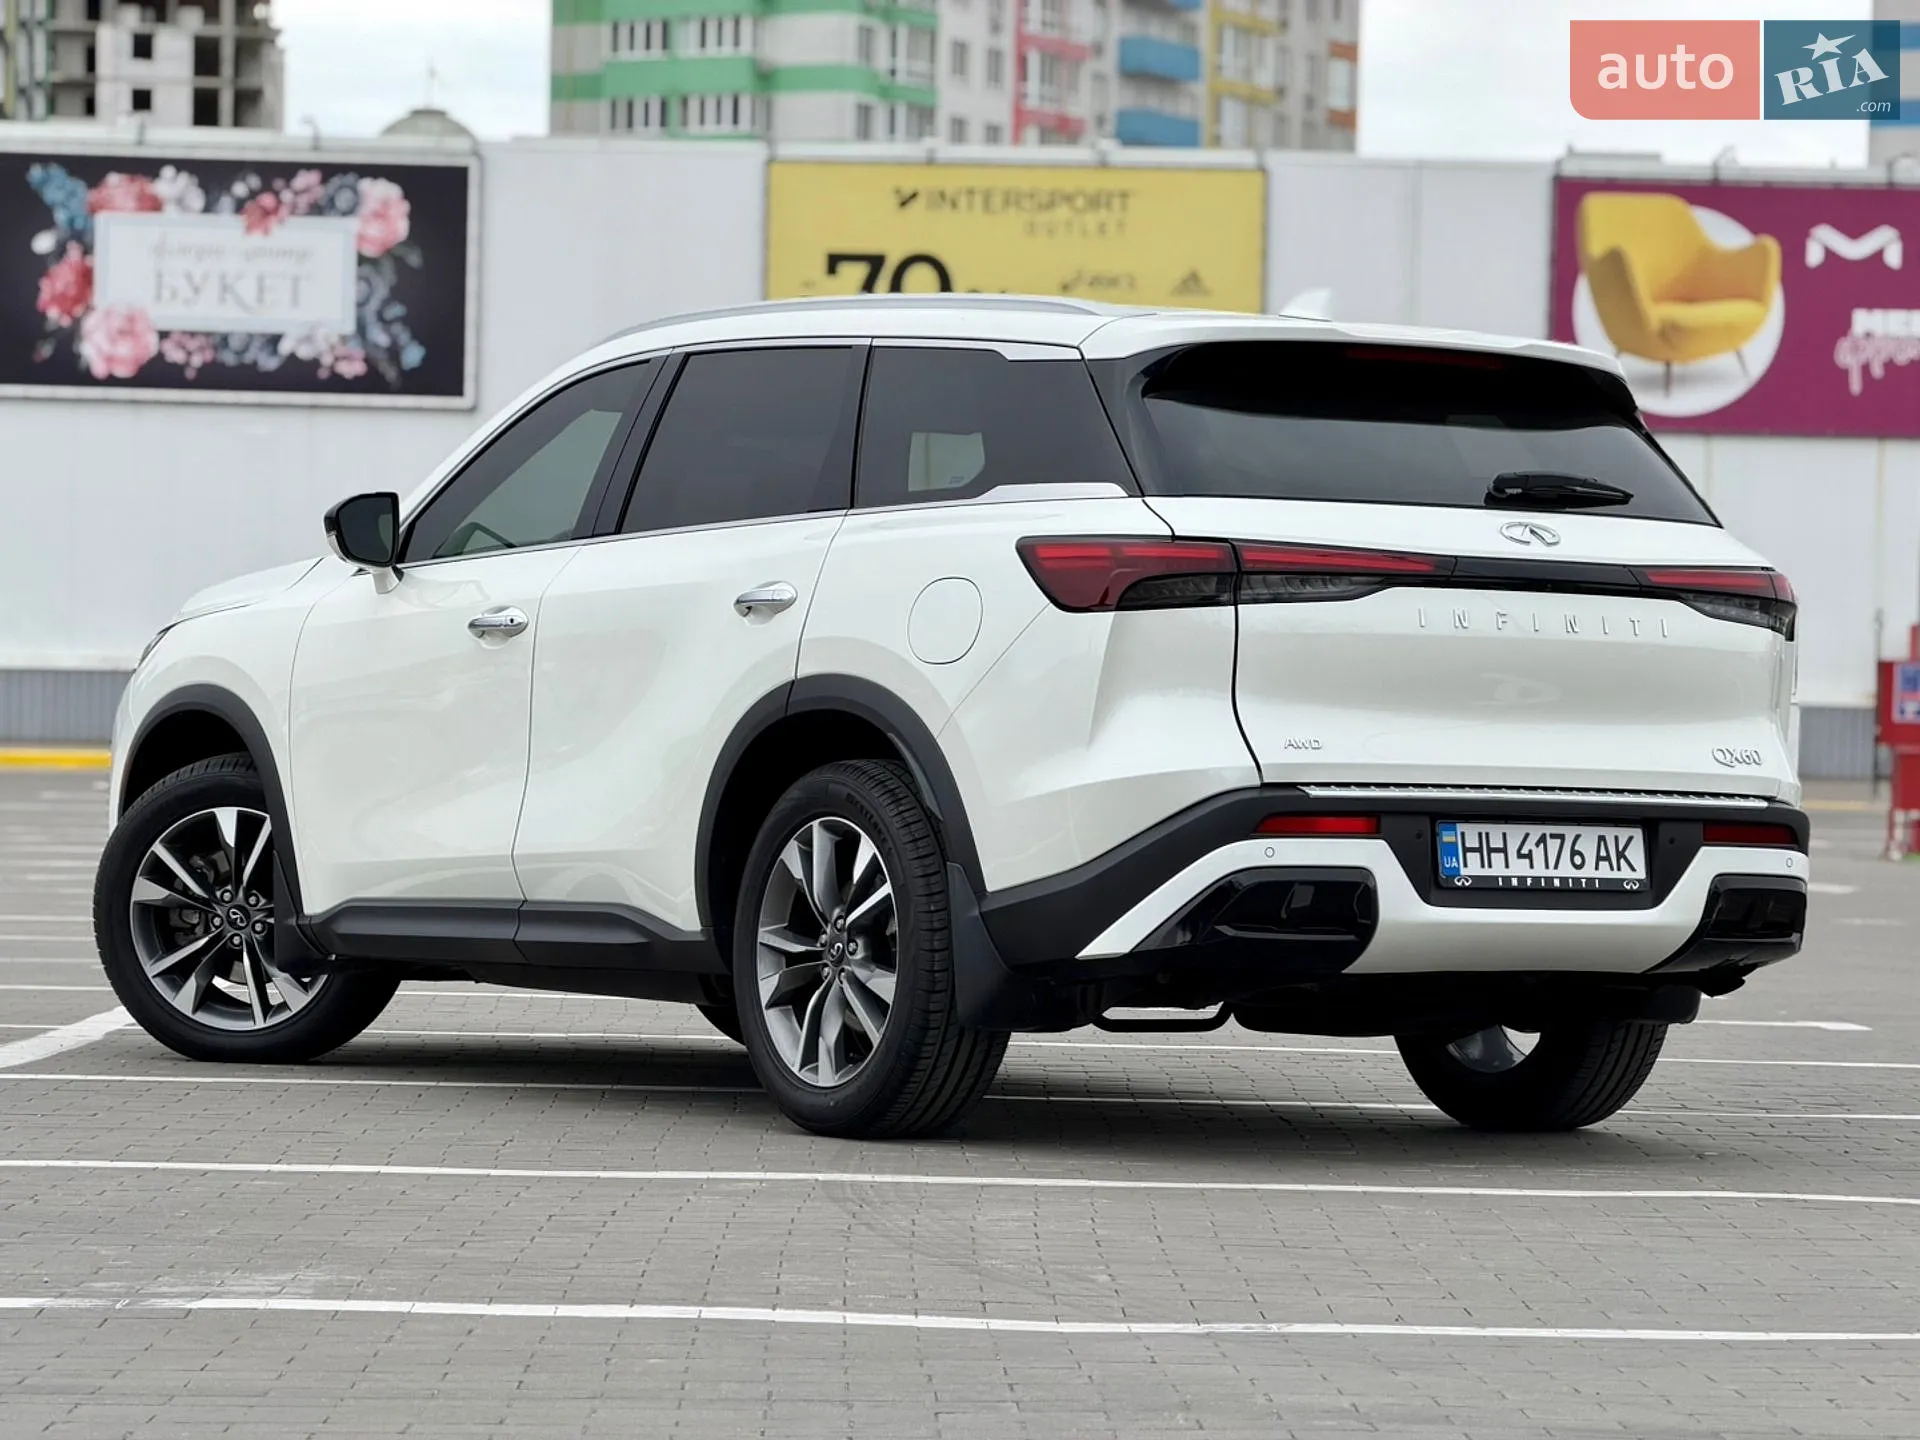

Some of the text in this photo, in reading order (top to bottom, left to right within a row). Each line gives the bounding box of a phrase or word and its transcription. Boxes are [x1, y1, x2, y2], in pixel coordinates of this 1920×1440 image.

[924, 185, 1133, 215] INTERSPORT
[1418, 606, 1669, 638] INFINITI
[1283, 735, 1323, 751] AWD
[1711, 745, 1763, 768] QX60
[1443, 856, 1459, 869] UA
[1460, 831, 1638, 872] HH 4176 AK
[1498, 876, 1600, 889] INFINITI
